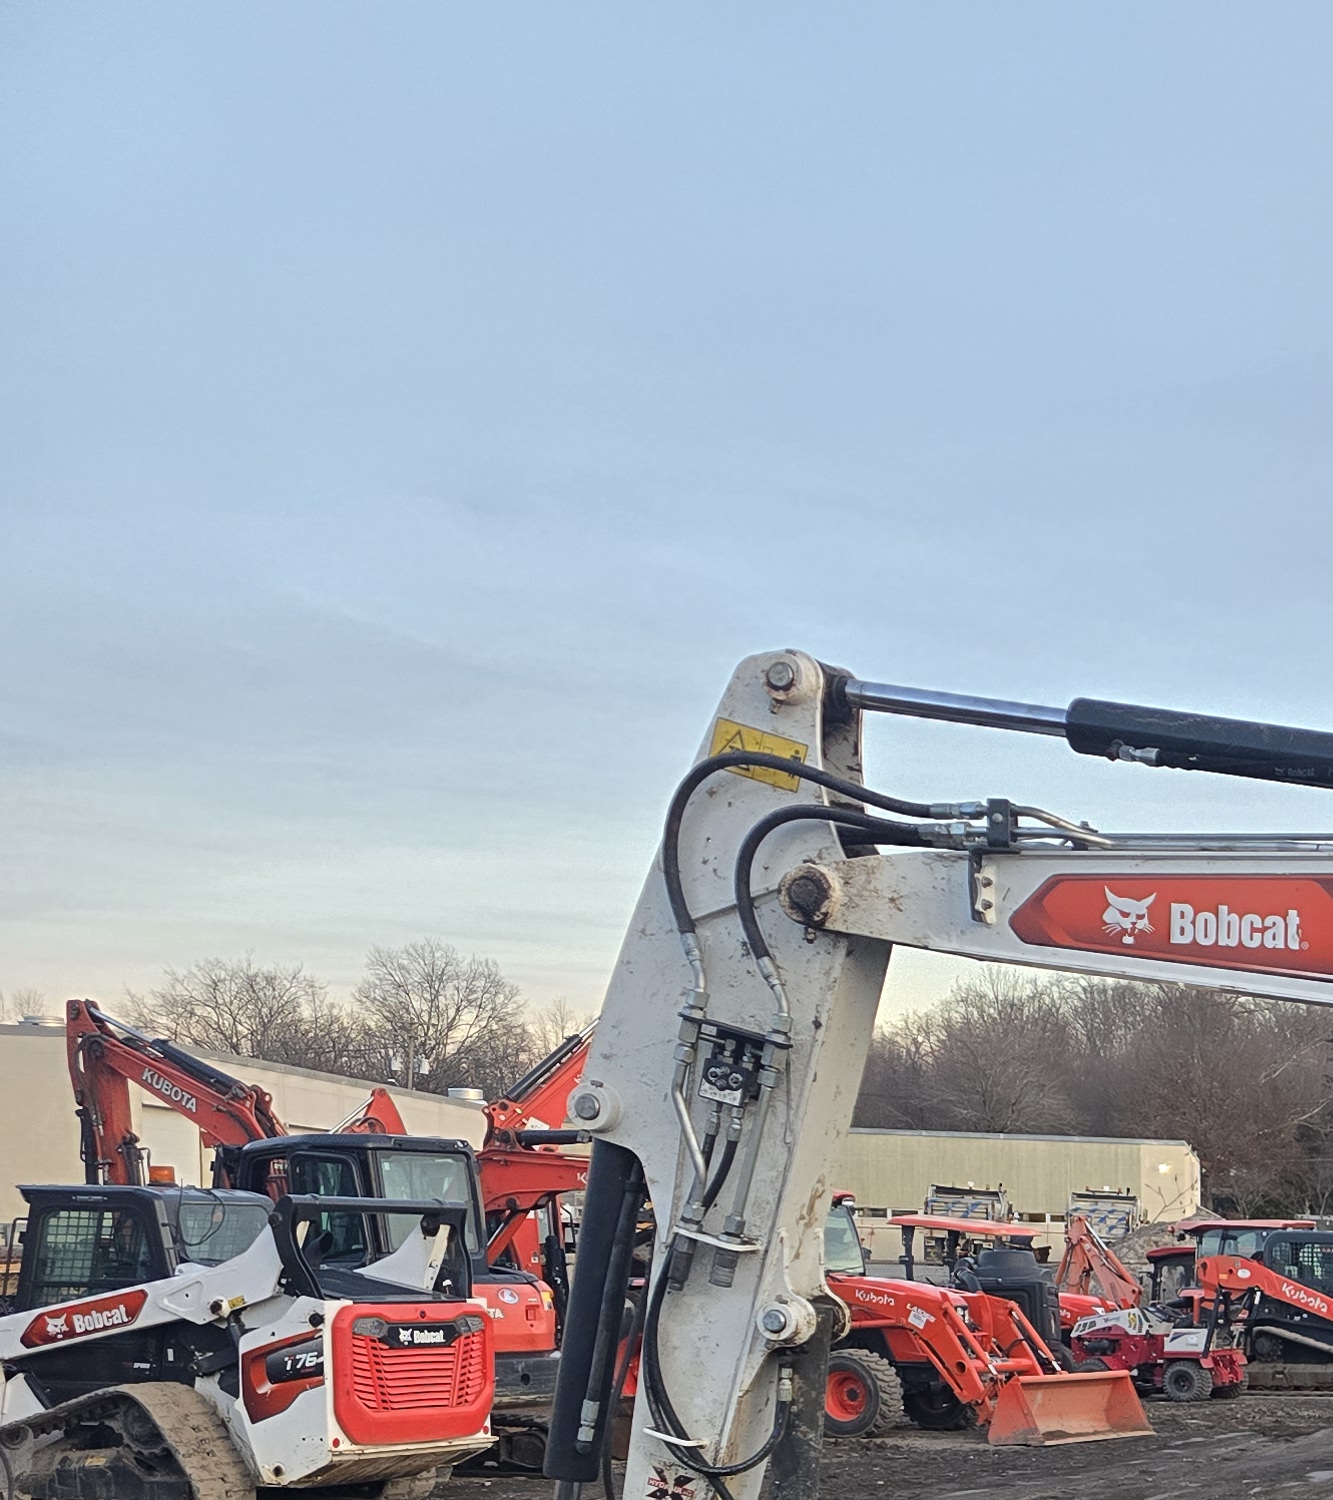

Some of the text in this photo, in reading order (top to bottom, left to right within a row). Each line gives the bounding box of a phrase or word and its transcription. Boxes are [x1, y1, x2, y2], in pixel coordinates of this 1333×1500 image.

[1170, 903, 1301, 950] Bobcat
[142, 1067, 197, 1113] KUBOTA
[855, 1289, 895, 1307] Kubota
[1282, 1282, 1328, 1313] Kubota
[72, 1304, 130, 1334] Bobcat
[413, 1330, 445, 1344] Bobcat
